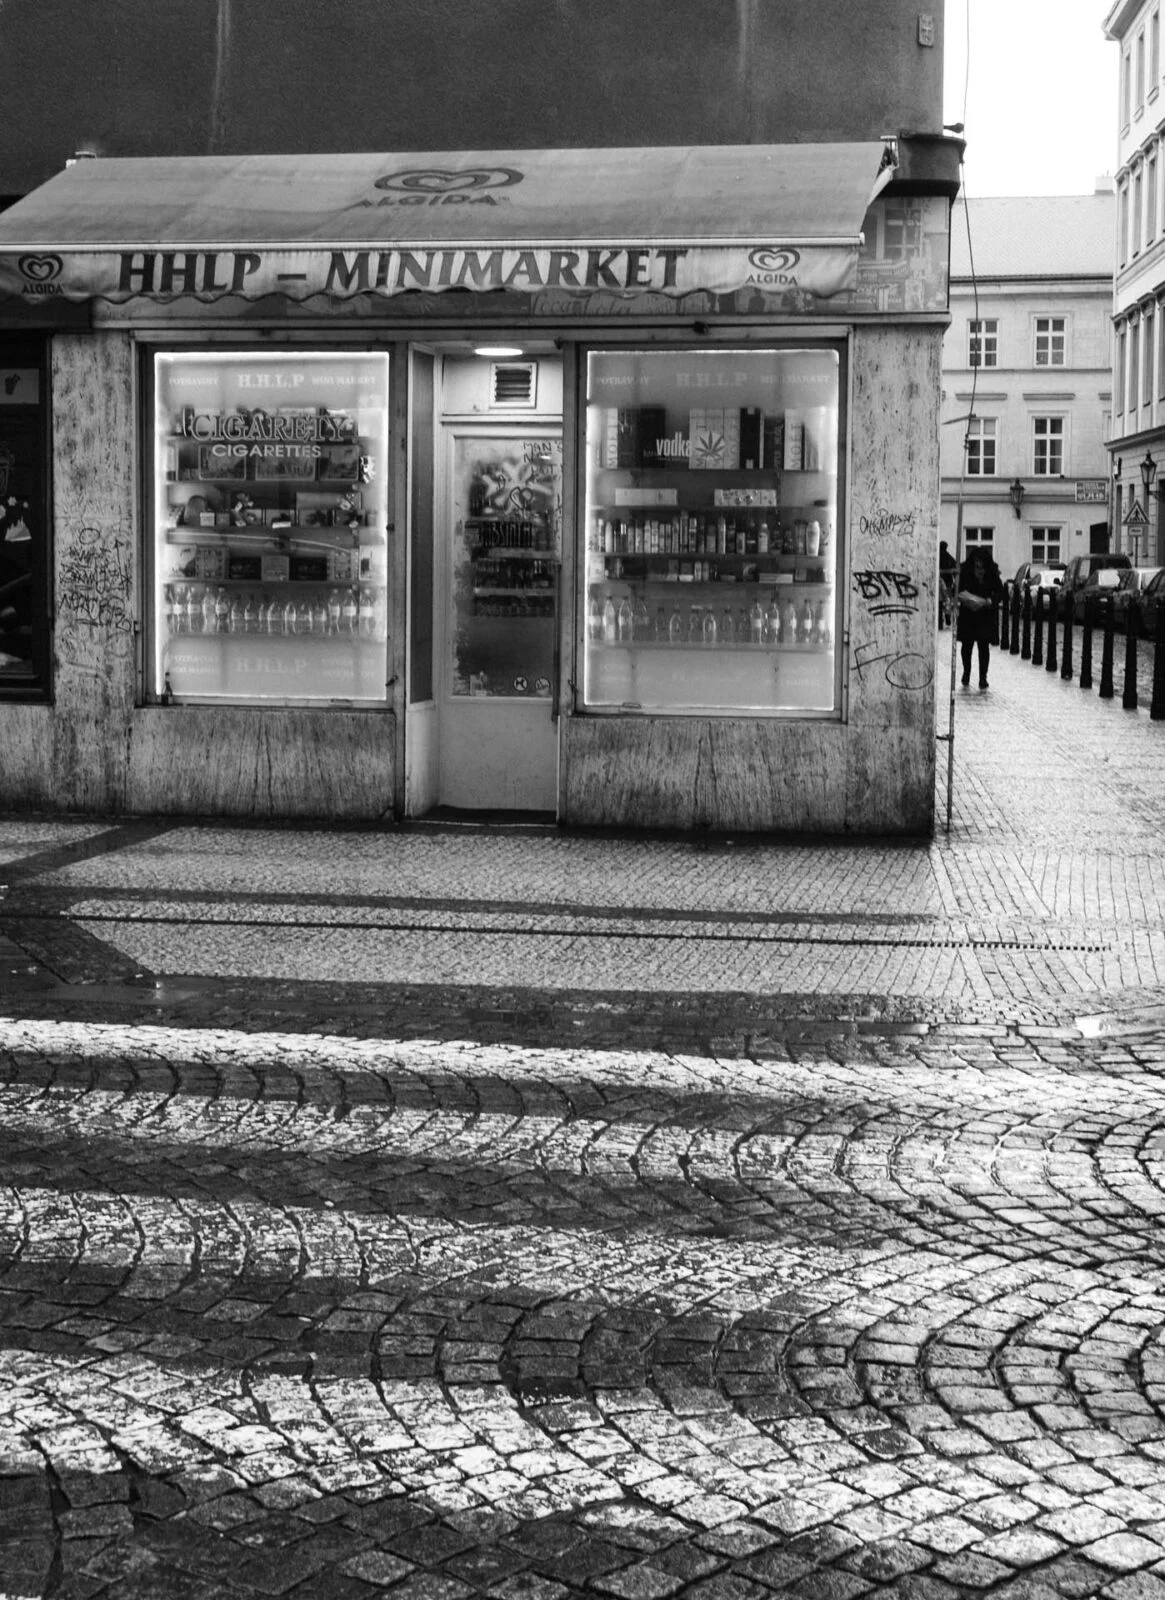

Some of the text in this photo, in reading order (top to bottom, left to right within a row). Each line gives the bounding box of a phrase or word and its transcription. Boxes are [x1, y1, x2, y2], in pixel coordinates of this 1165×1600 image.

[356, 194, 499, 207] ALGIDA
[118, 252, 262, 293] HHLP
[326, 249, 688, 291] MINIMARKET
[745, 273, 800, 286] ALGIDA
[21, 283, 64, 295] ALGIDA
[211, 443, 322, 458] CIGARETTES
[656, 431, 692, 457] vodka
